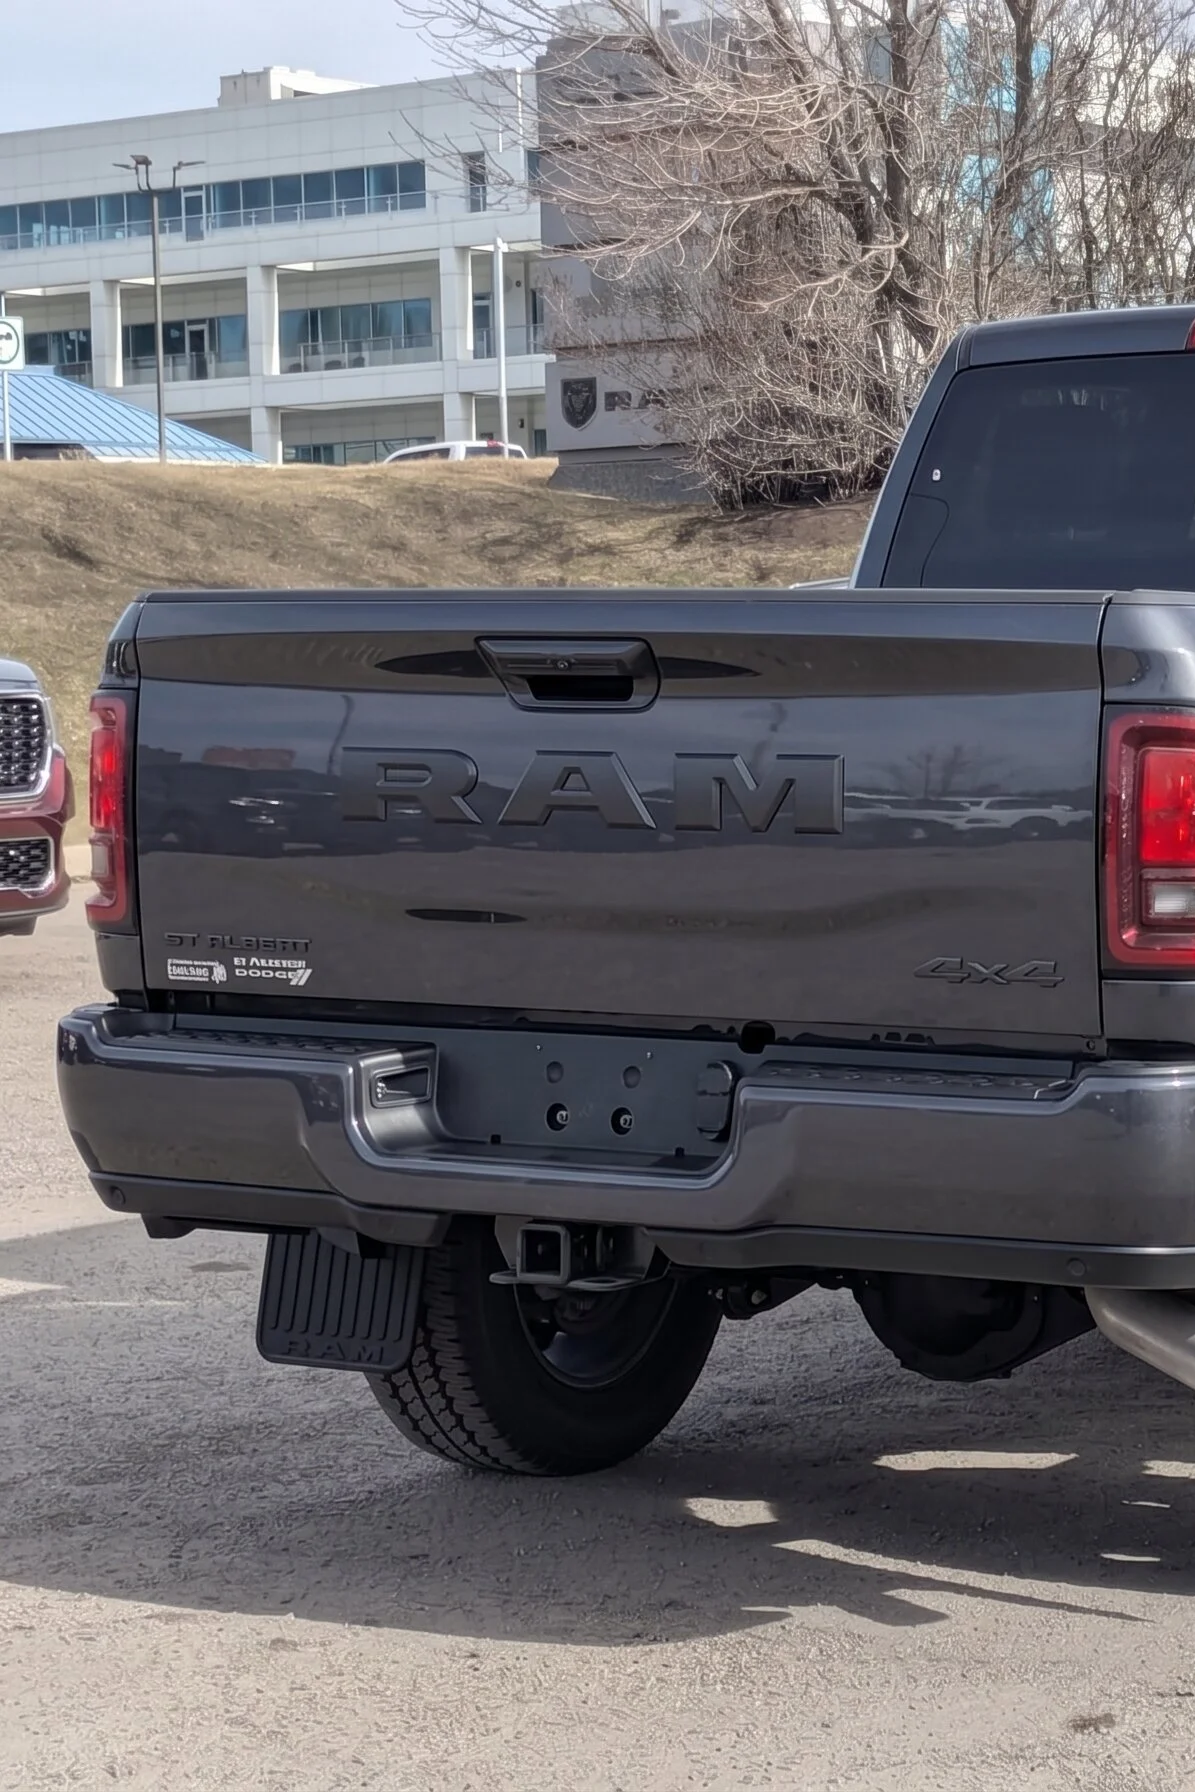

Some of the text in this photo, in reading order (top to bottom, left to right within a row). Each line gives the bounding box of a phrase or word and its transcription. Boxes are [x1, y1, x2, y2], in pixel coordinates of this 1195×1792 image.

[341, 746, 845, 834] RAM
[164, 932, 200, 948] ST
[914, 956, 1065, 988] 4x4
[281, 1339, 384, 1363] RAM
